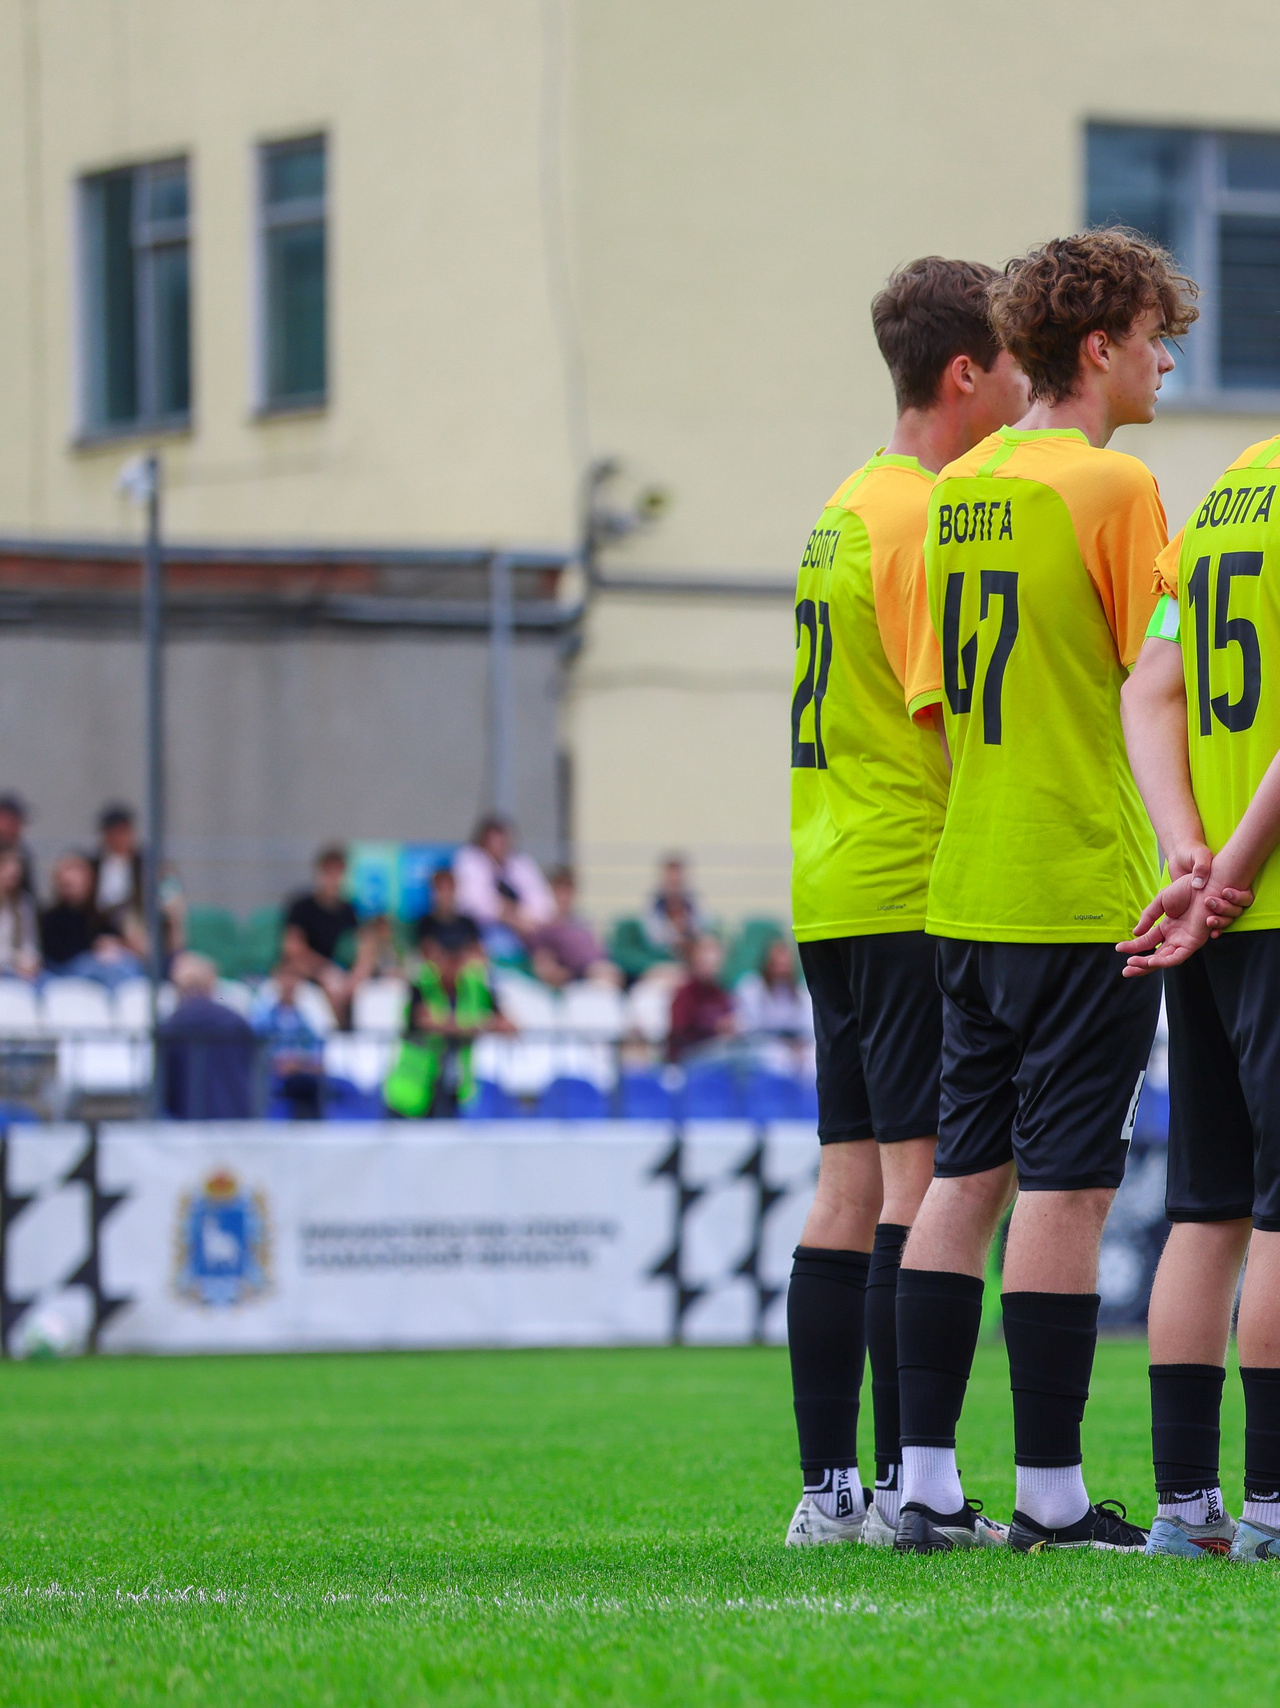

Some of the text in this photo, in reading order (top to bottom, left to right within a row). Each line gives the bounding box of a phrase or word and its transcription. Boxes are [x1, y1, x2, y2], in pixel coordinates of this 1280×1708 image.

[801, 529, 841, 570] ВОЛГА
[938, 501, 1014, 546] ВОЛГА
[1195, 485, 1277, 529] ВОЛГА
[791, 599, 832, 770] 21
[943, 570, 1019, 745] 47
[1188, 551, 1264, 736] 15
